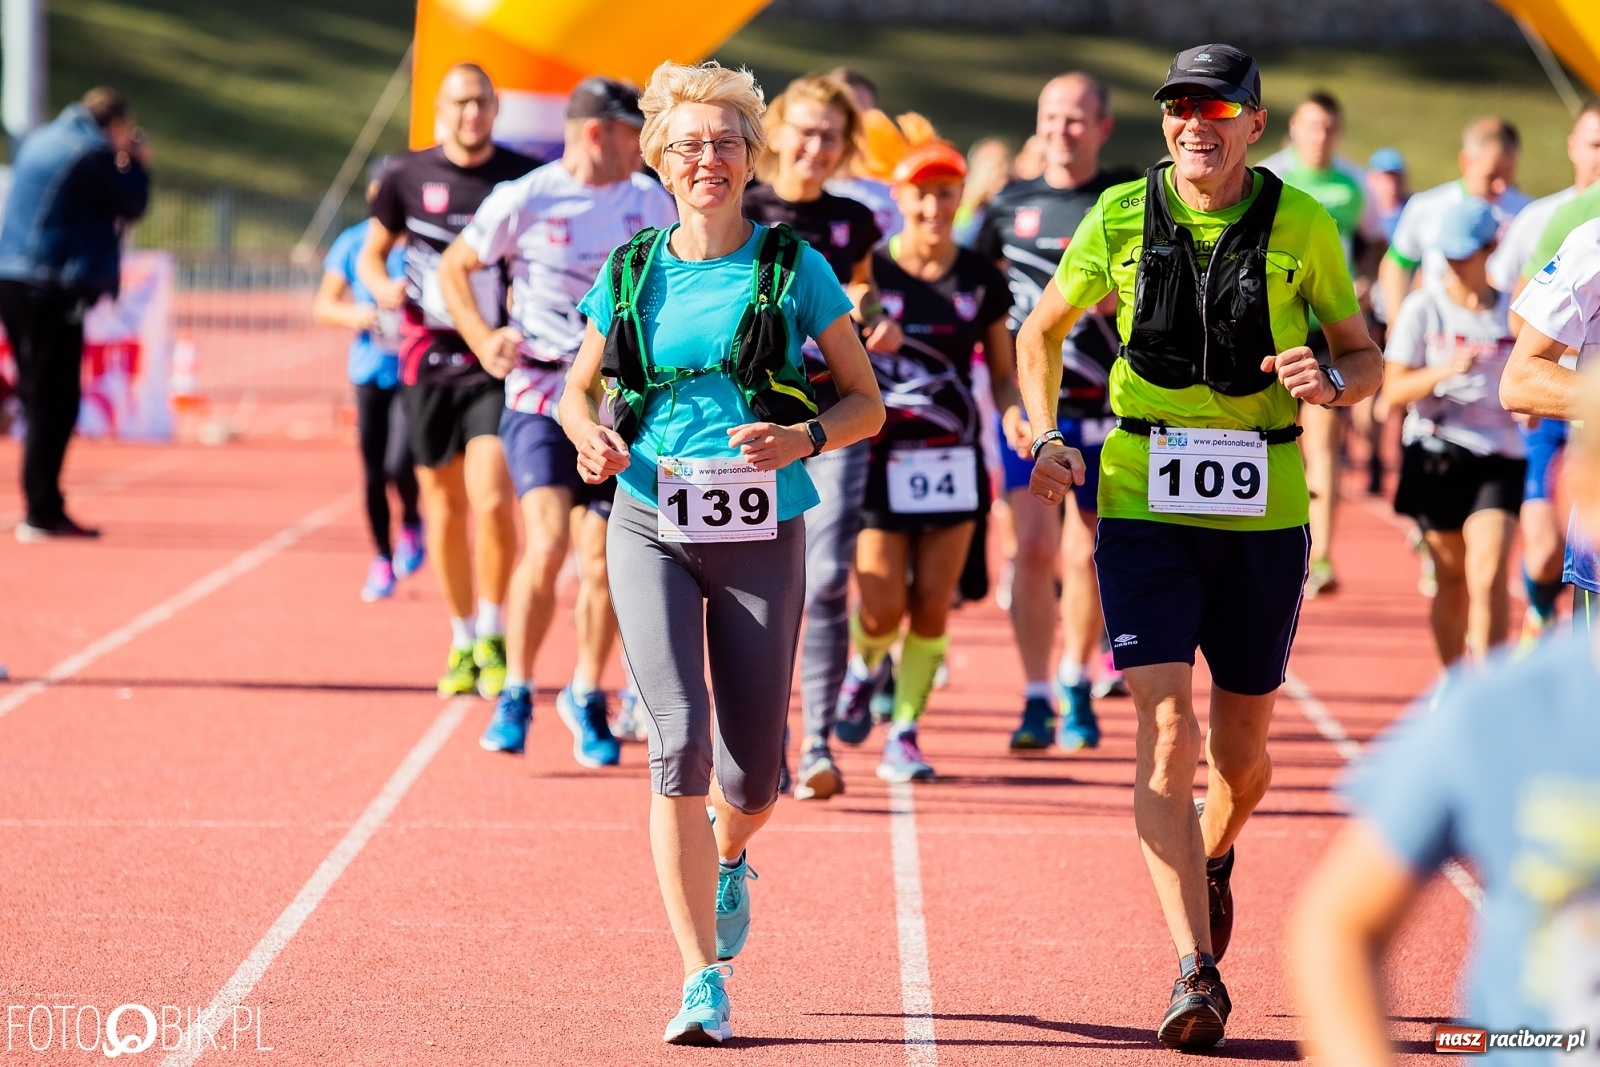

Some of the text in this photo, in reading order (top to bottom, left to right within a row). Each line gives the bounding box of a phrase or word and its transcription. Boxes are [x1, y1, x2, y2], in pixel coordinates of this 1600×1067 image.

[1193, 438, 1263, 448] www.personalbest.pl
[698, 465, 770, 476] www.personalbe
[1158, 458, 1261, 500] 109
[909, 472, 955, 501] 94
[667, 487, 770, 527] 139
